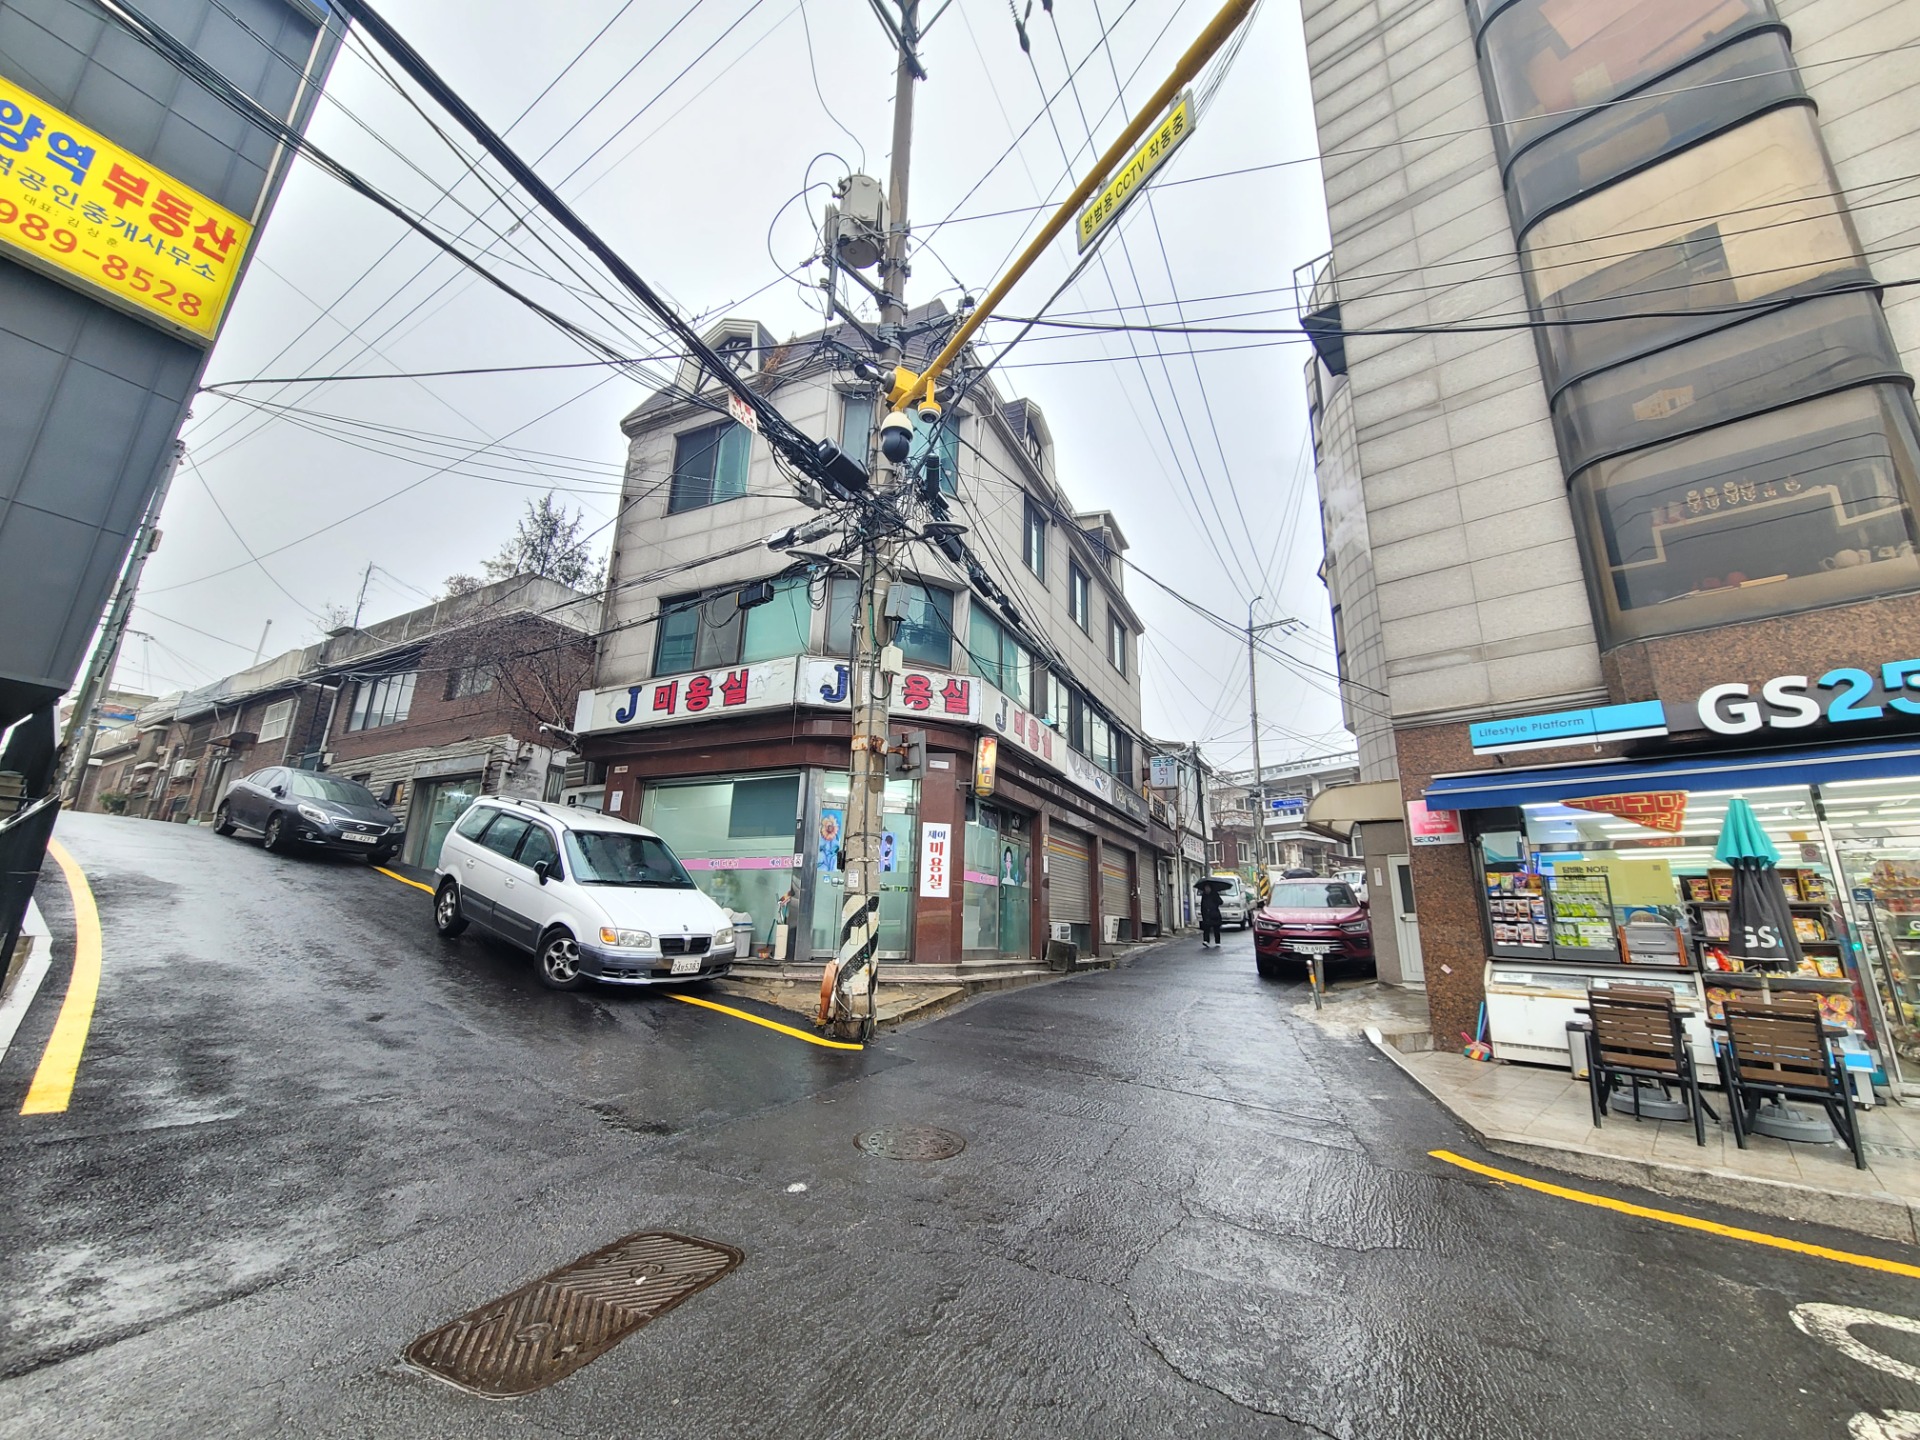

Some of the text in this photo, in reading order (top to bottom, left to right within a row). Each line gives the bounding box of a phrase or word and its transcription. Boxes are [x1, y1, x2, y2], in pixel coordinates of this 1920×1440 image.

[1083, 111, 1184, 234] 방범용 CCTV 작동중
[102, 162, 237, 264] 부동산
[615, 669, 750, 724] J 미용실
[887, 672, 970, 715] 용실
[1014, 709, 1052, 761] 미용실
[1479, 717, 1584, 738] Lifestyle Platform
[1413, 835, 1441, 843] SECOM
[927, 841, 945, 890] 미용실
